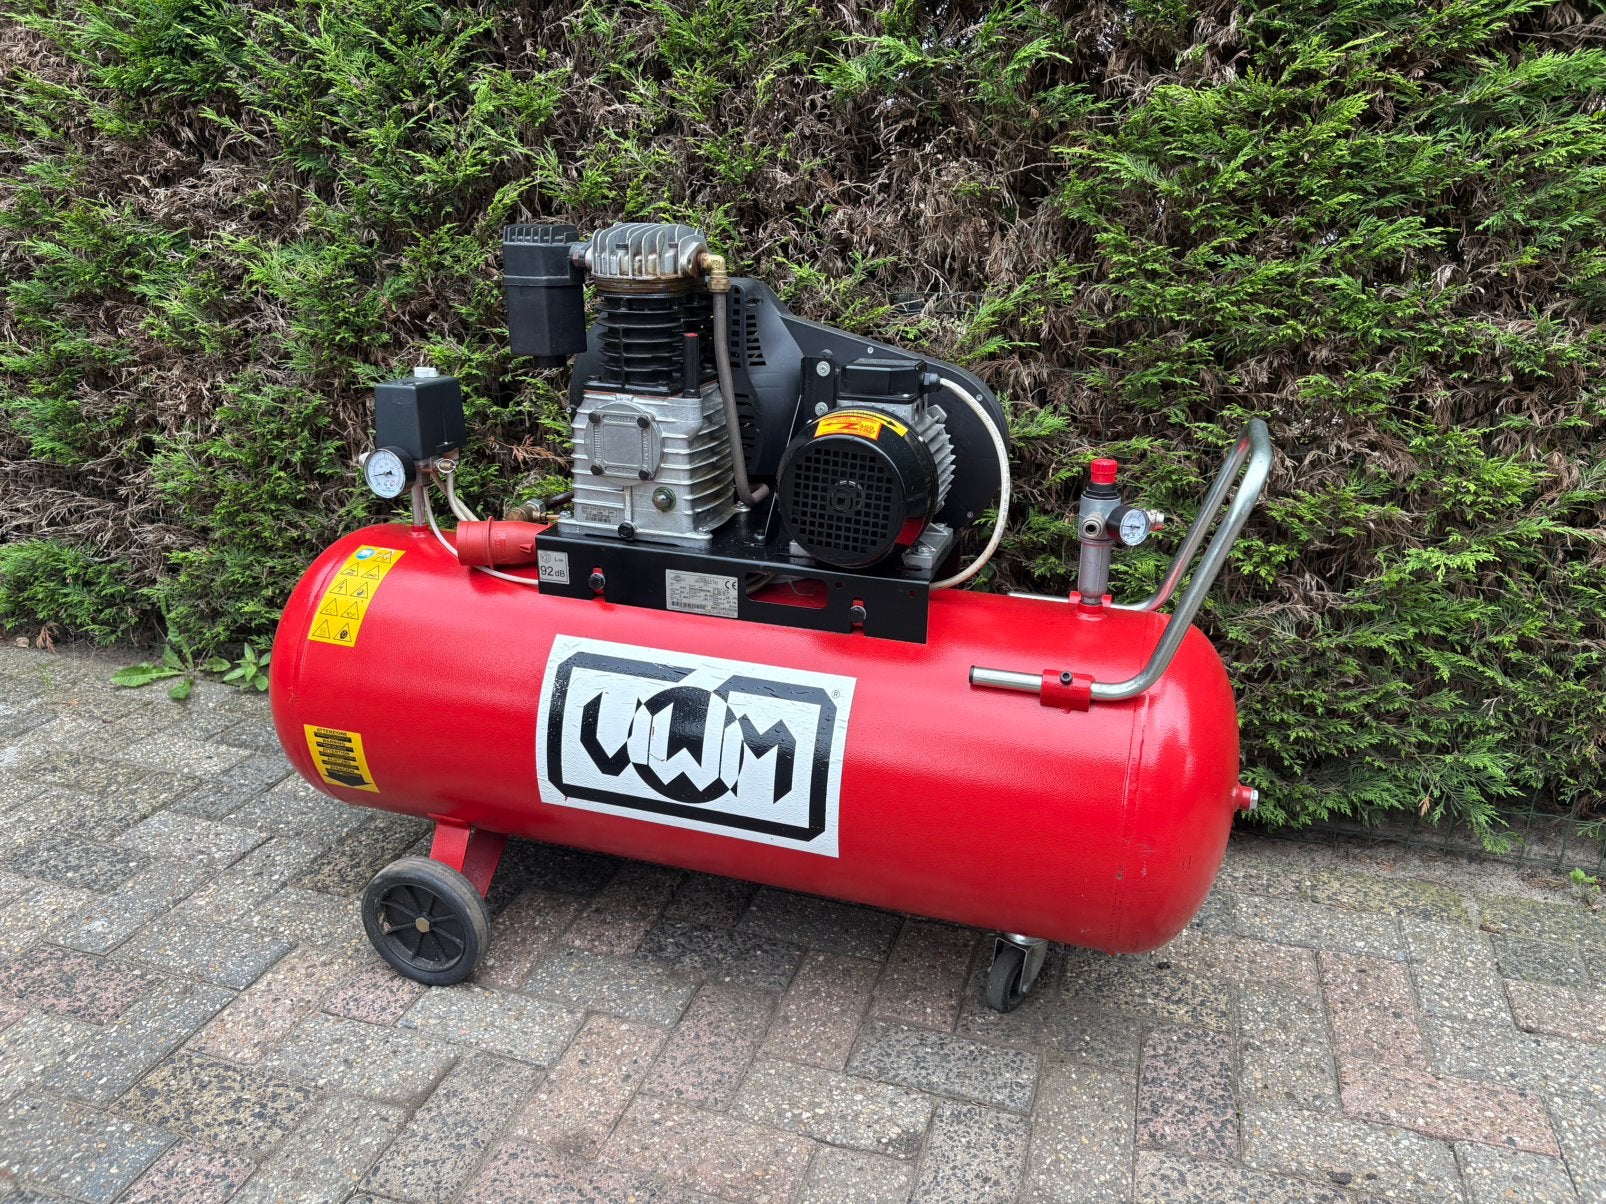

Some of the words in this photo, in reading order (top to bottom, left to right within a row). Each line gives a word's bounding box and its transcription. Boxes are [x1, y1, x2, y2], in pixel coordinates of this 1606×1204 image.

[540, 565, 554, 576] 92
[555, 569, 566, 578] dB
[317, 728, 347, 736] ATTENZIONE
